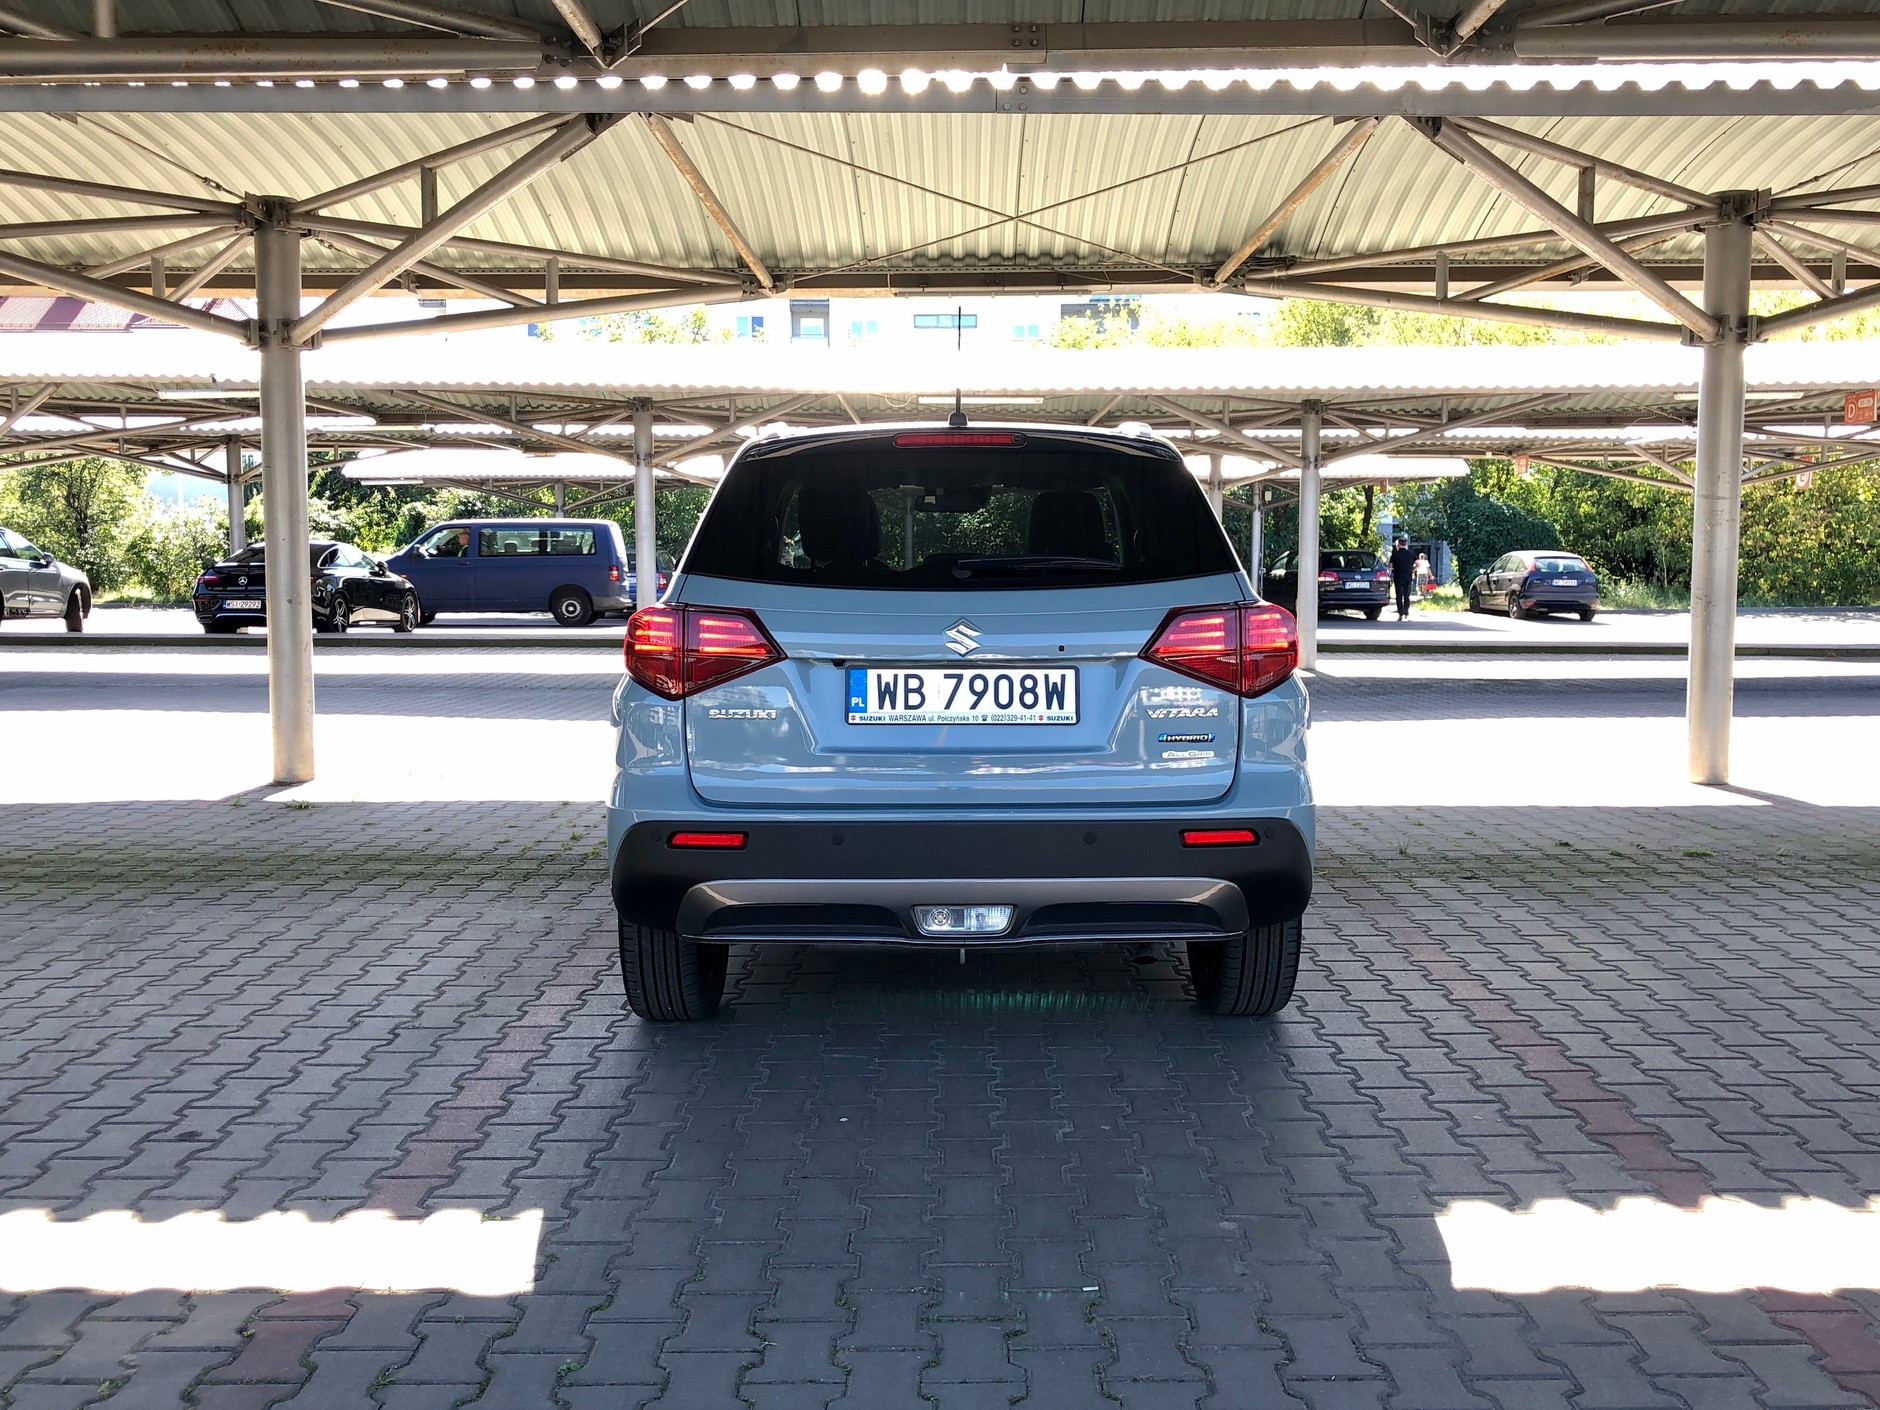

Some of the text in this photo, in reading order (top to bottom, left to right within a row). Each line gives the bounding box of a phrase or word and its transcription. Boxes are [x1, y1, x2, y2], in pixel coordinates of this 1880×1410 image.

[877, 673, 1066, 710] WB 7908W
[851, 696, 865, 707] PL
[708, 708, 777, 720] SUZUKI
[888, 714, 927, 722] WARSZAWA
[928, 714, 936, 722] ul.
[972, 714, 979, 722] 10
[1146, 707, 1218, 718] VITARA
